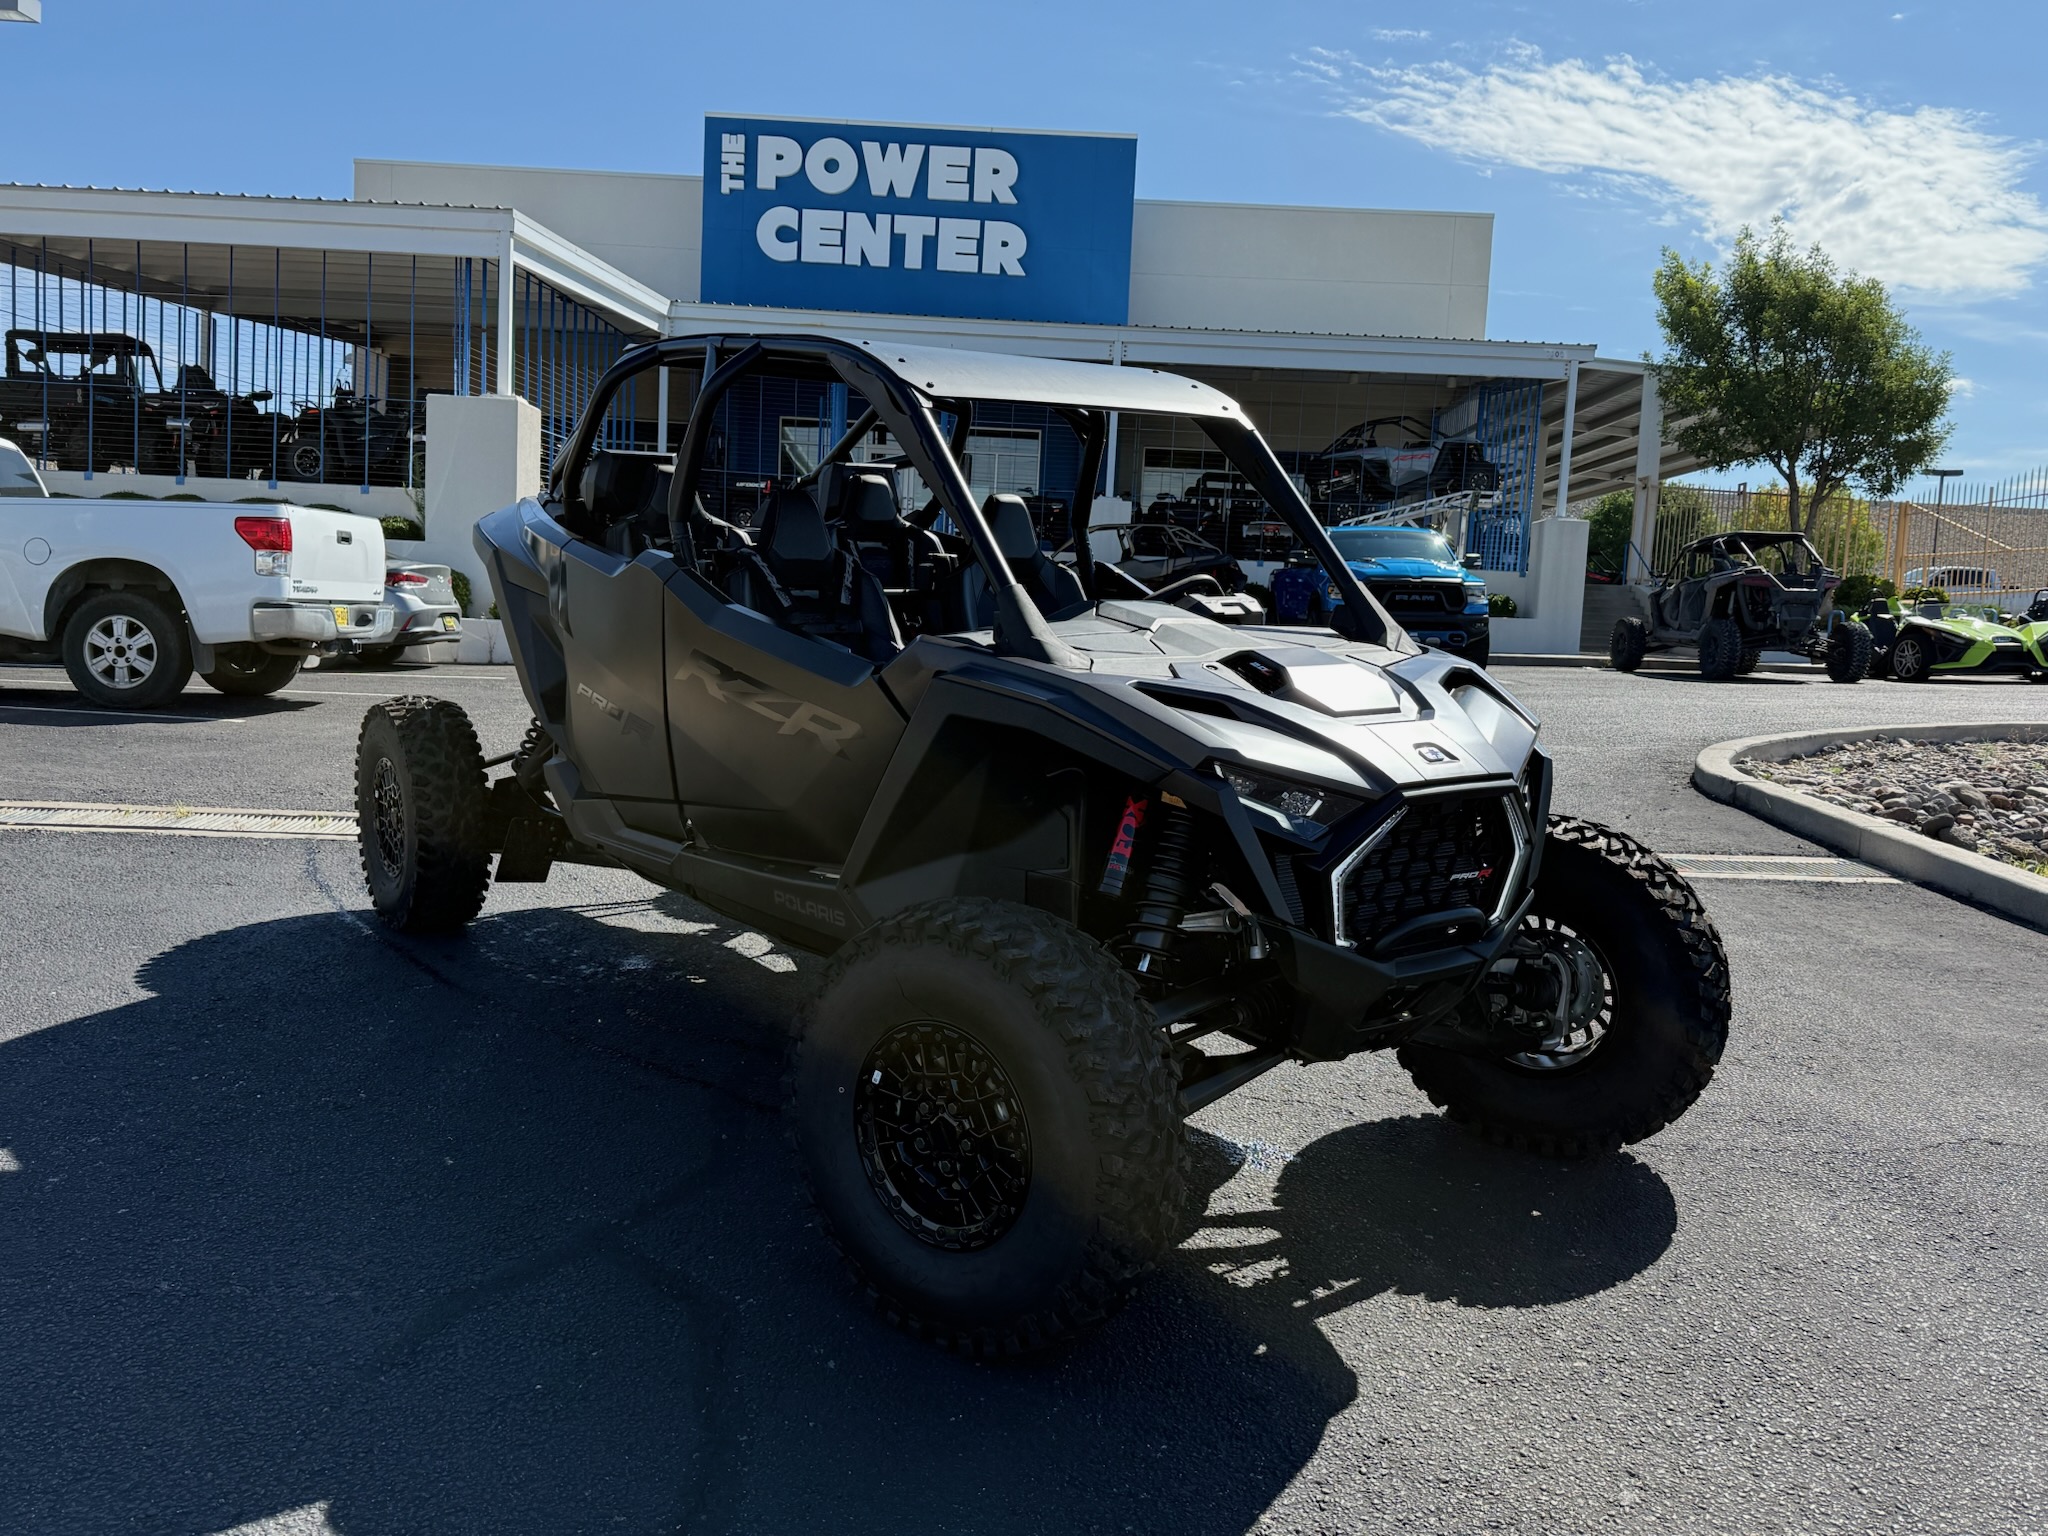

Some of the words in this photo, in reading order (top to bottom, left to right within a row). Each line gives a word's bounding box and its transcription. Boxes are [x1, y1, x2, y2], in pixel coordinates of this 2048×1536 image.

[721, 133, 745, 195] THE
[756, 134, 1019, 205] POWER
[756, 205, 1028, 277] CENTER
[576, 682, 625, 722] PRO
[674, 648, 863, 761] RZR
[773, 889, 847, 928] POLARIS
